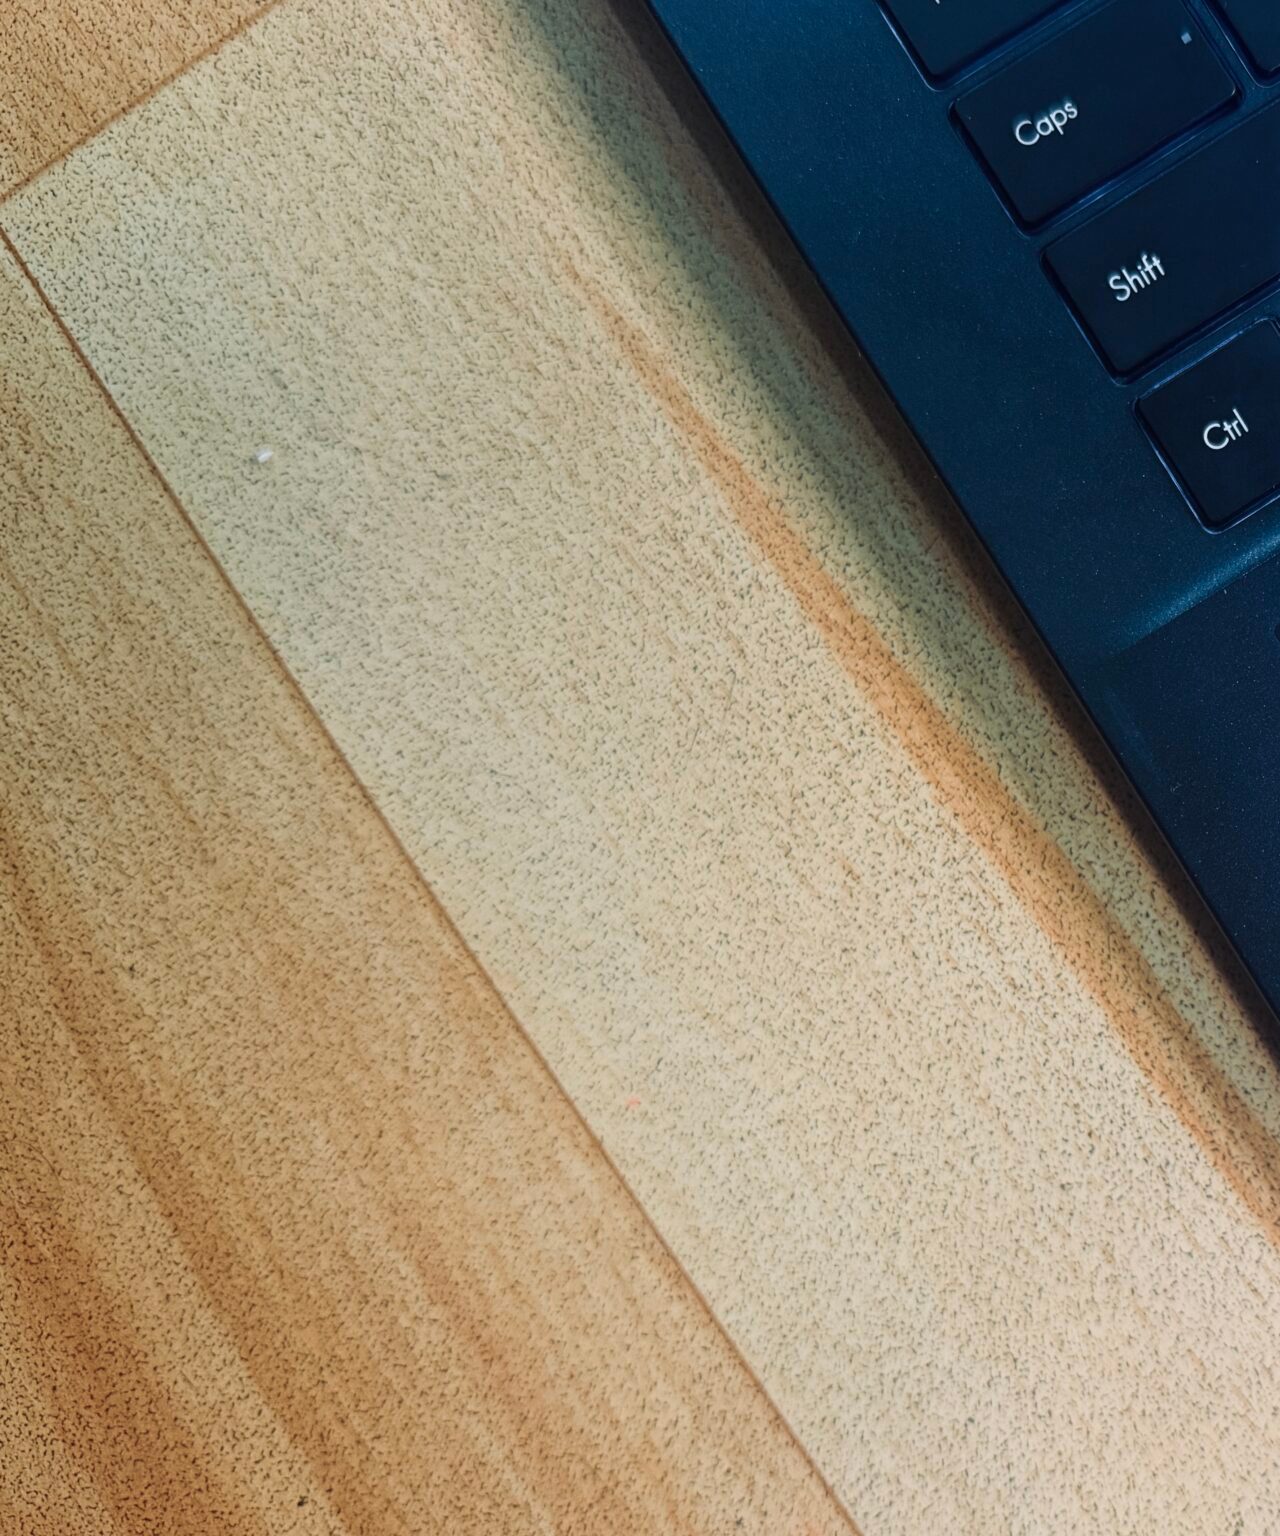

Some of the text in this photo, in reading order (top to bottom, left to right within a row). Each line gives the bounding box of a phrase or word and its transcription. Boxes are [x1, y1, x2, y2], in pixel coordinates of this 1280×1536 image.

[1015, 102, 1078, 146] Caps
[1108, 252, 1166, 302] Shift
[1202, 410, 1250, 450] Ctrl
